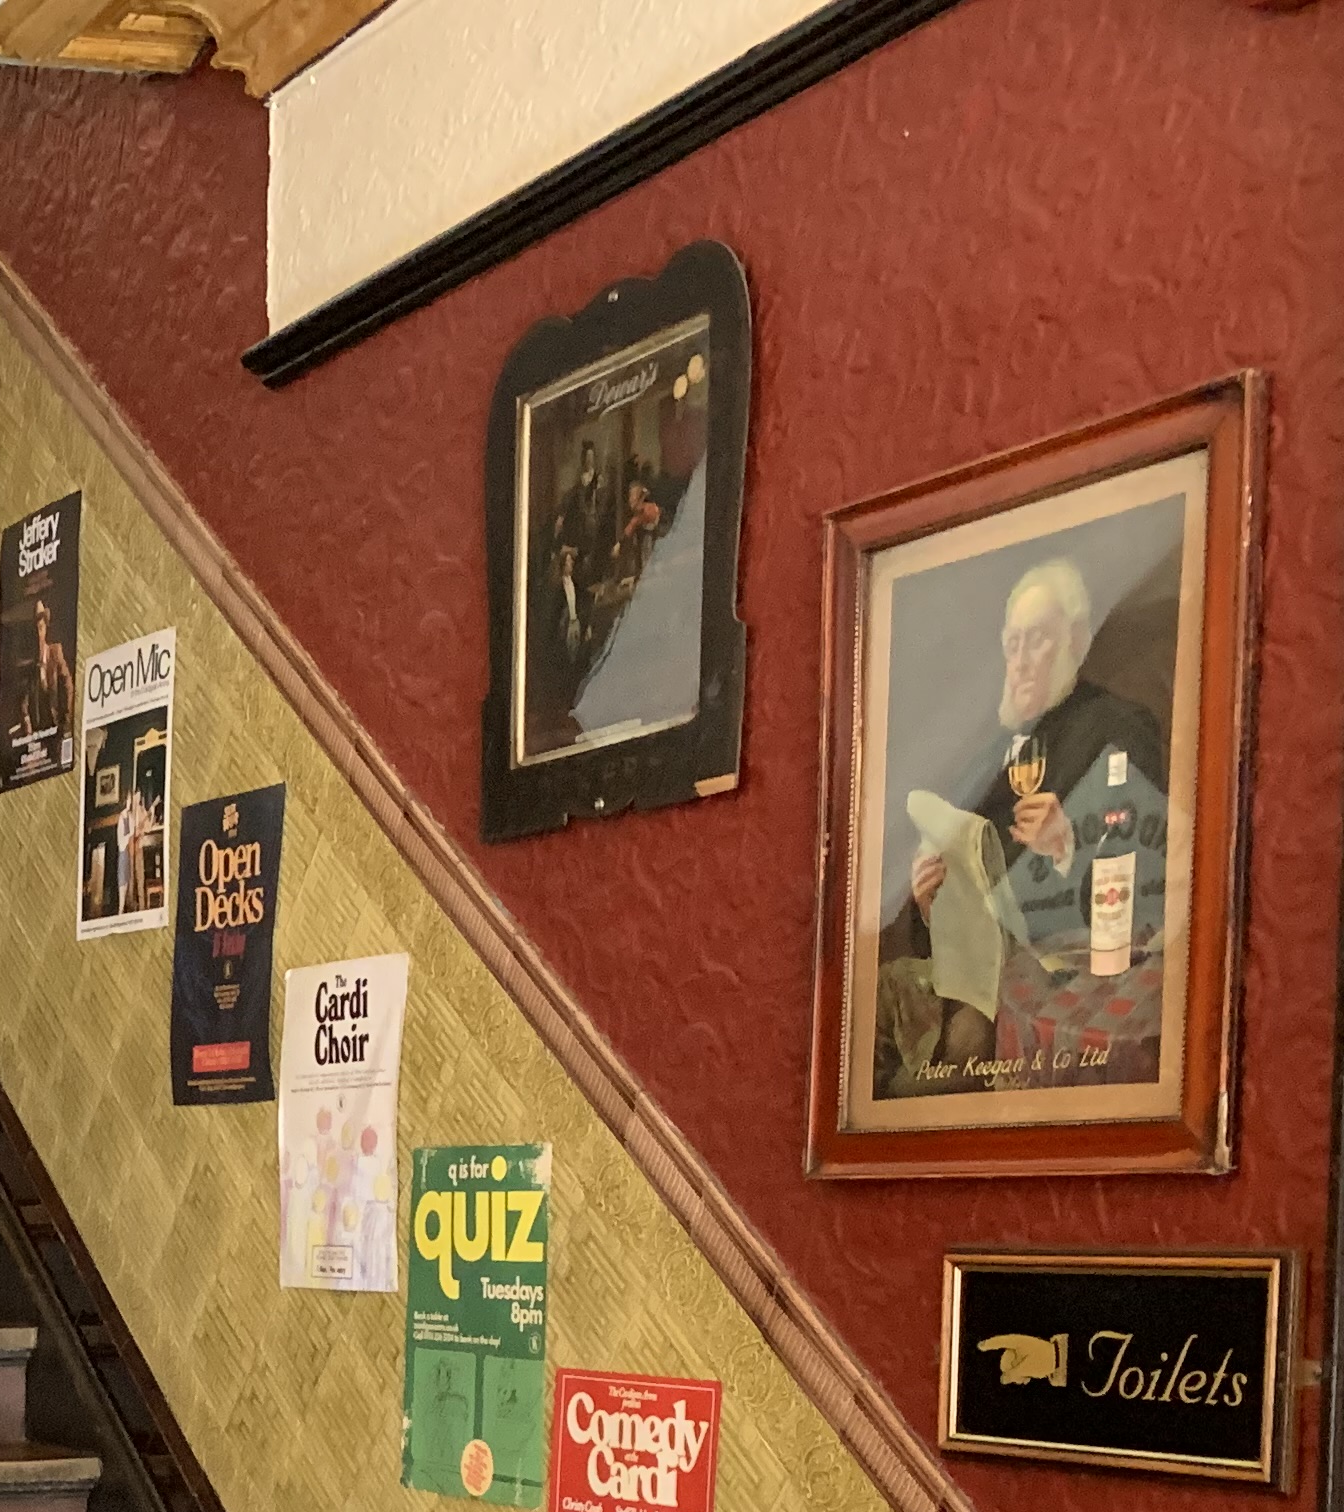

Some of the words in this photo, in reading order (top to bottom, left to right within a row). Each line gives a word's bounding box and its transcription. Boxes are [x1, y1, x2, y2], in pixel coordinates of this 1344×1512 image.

[19, 512, 59, 549] Jeffery
[88, 661, 134, 708] Open
[136, 643, 171, 687] Mic
[199, 838, 261, 893] Open
[194, 879, 264, 933] Decks
[315, 978, 368, 1023] Cardi
[335, 974, 347, 988] The
[315, 1024, 369, 1066] Choir
[916, 1059, 957, 1081] Peter
[963, 1055, 1025, 1087] Keegan
[1031, 1049, 1043, 1070] &
[1053, 1046, 1071, 1069] Co
[1079, 1041, 1111, 1067] Ltd
[448, 1163, 458, 1186] q
[459, 1158, 468, 1179] is
[469, 1155, 489, 1179] for
[480, 1275, 544, 1308] Tuesdays
[511, 1301, 543, 1332] 8pm
[1081, 1330, 1248, 1408] Toilets
[567, 1392, 709, 1473] Comedy
[587, 1445, 678, 1507] Cardi
